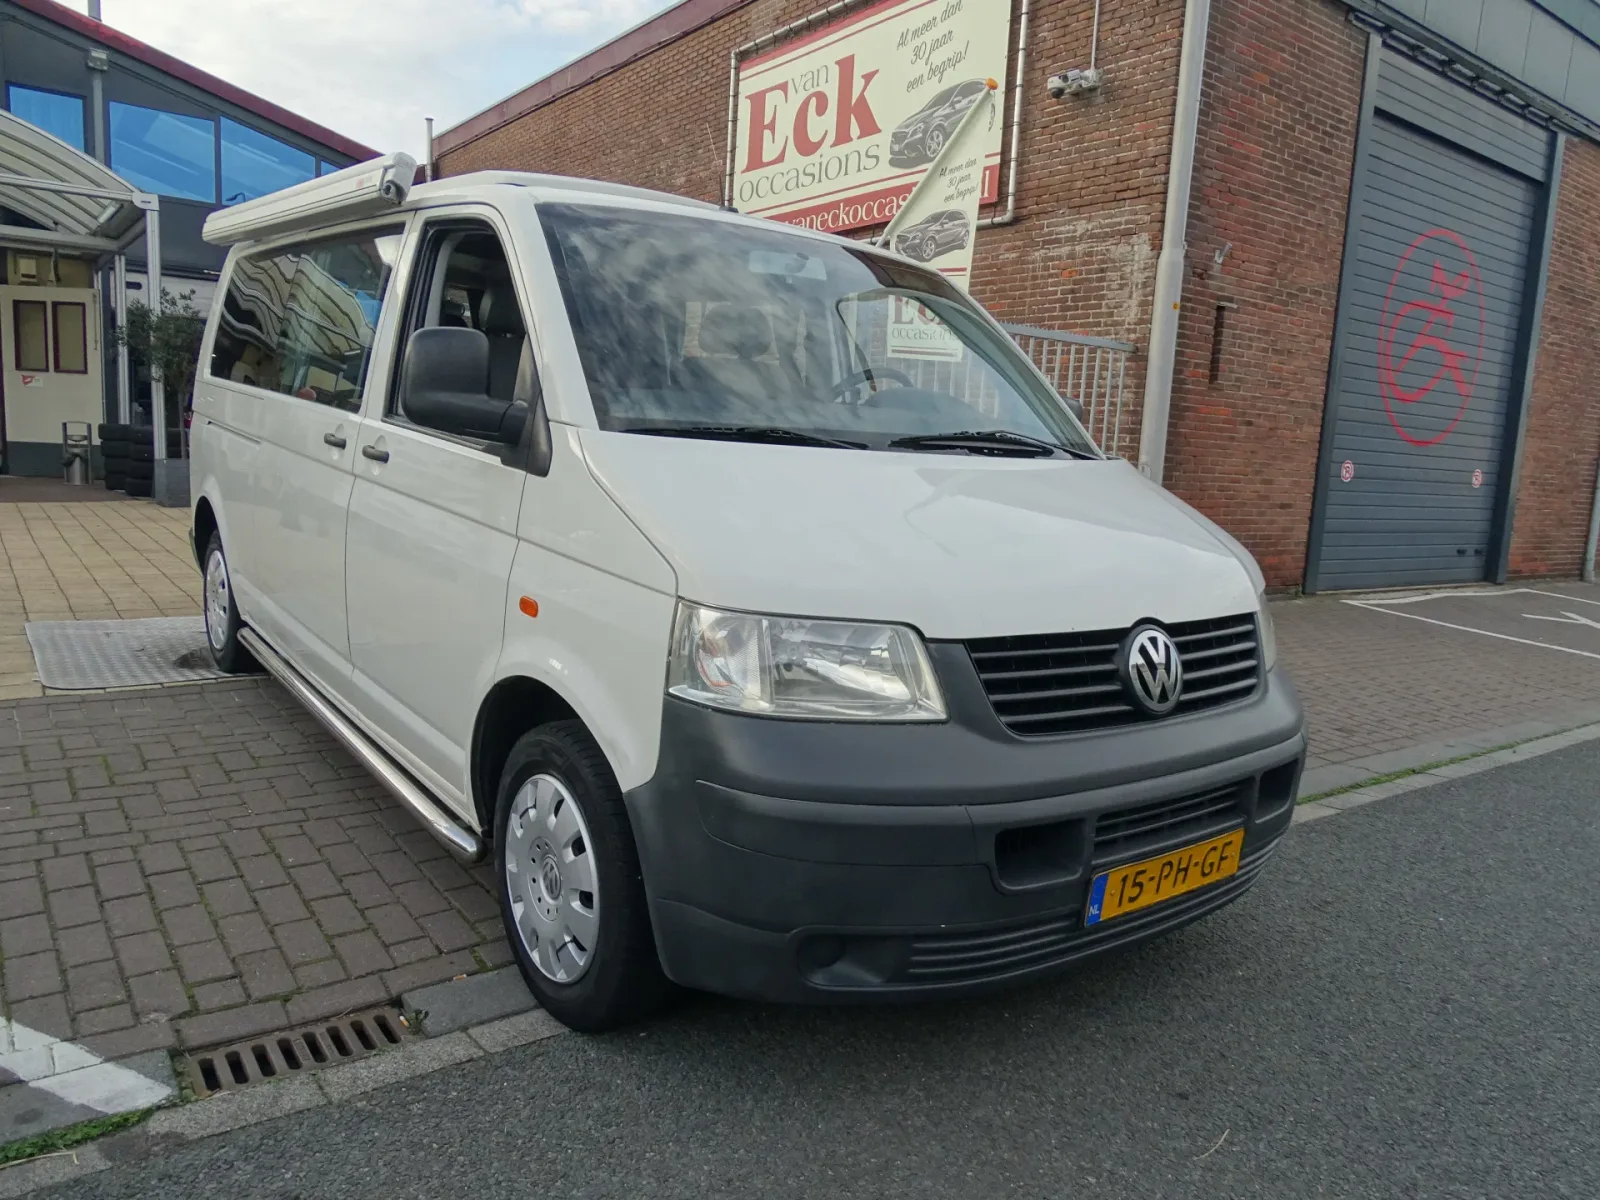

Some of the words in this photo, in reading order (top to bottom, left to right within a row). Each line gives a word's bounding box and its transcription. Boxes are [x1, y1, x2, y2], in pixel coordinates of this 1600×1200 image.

[897, 28, 909, 51] Al
[910, 16, 938, 43] meer
[940, 0, 963, 23] dan
[910, 41, 927, 65] 30
[925, 29, 953, 66] jaar
[791, 64, 830, 96] van
[906, 73, 925, 93] een
[927, 40, 969, 84] begrip!
[741, 53, 882, 174] Eck
[739, 144, 880, 203] occasions
[1117, 839, 1233, 909] 15-PH-GF
[1088, 903, 1101, 917] NL
